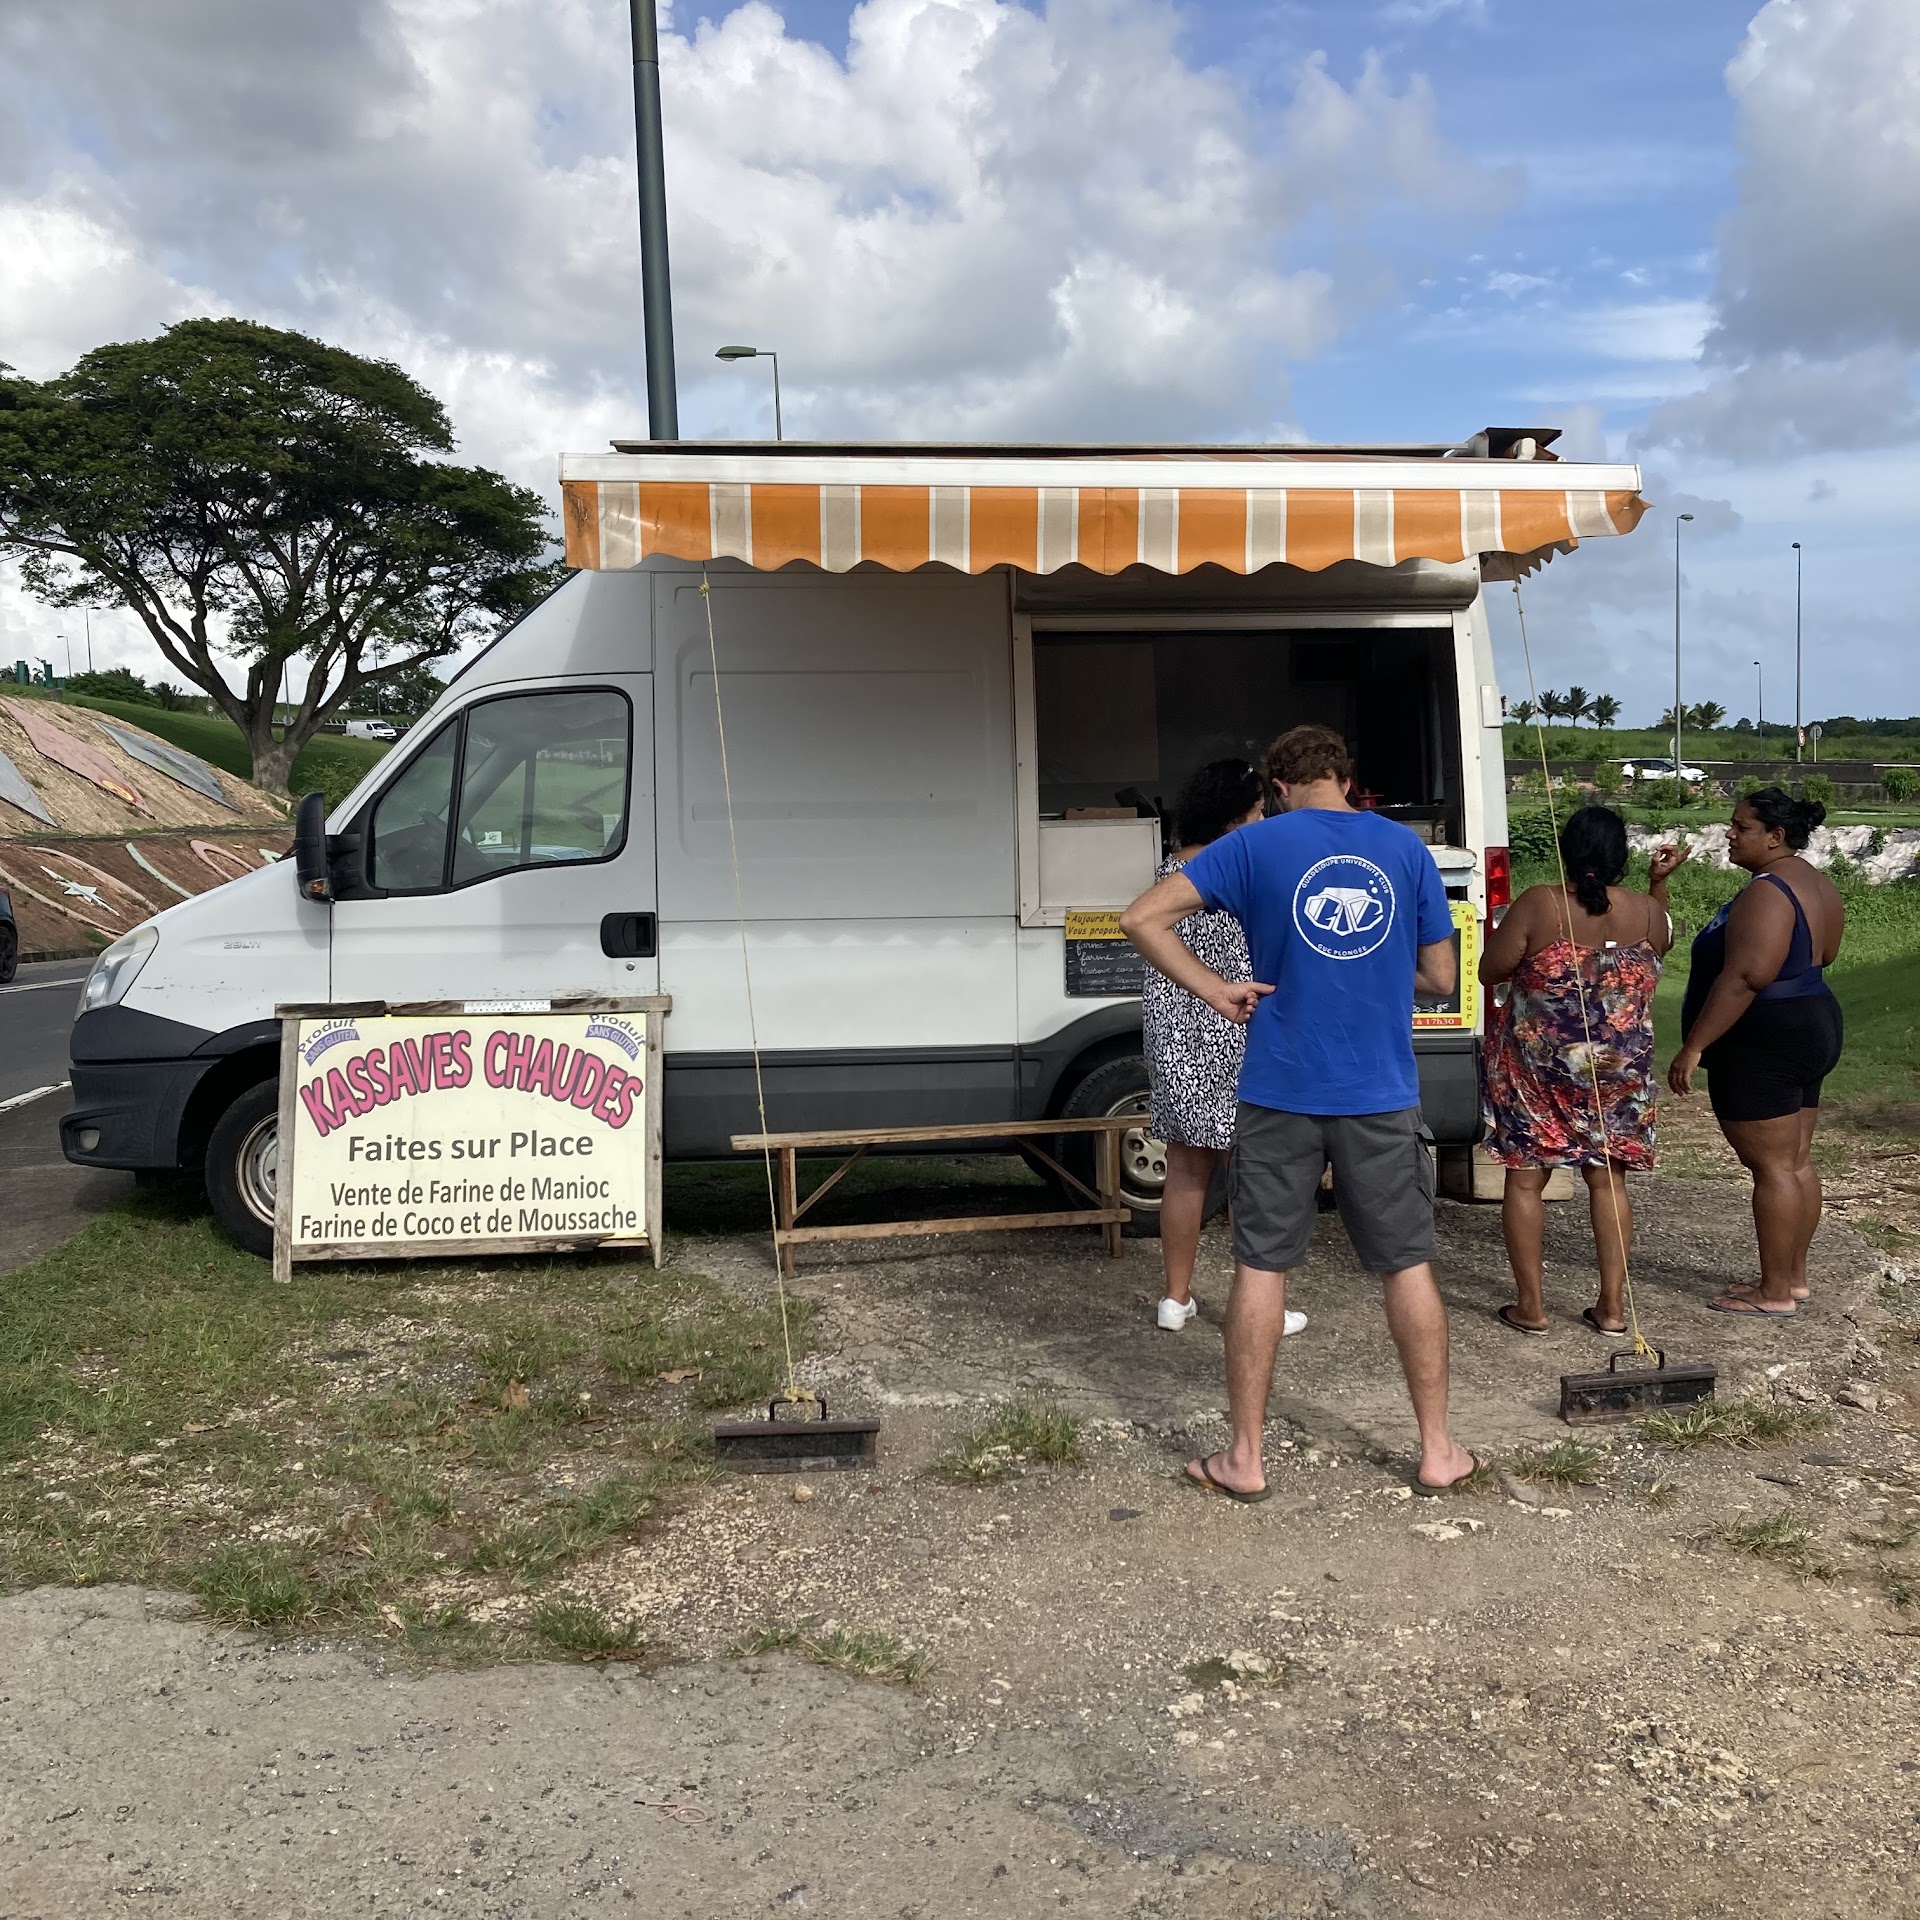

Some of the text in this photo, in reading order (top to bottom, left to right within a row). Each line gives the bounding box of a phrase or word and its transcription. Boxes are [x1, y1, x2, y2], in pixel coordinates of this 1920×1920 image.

[1301, 859, 1339, 889] GUADELOUPE
[1378, 876, 1390, 894] CLUB
[1068, 926, 1088, 935] Vous
[1117, 952, 1141, 960] coco
[1317, 943, 1332, 955] GUC
[1465, 914, 1474, 1020] Menu du Jour
[297, 1018, 357, 1053] Produit
[589, 1014, 647, 1046] Produit
[1425, 1017, 1455, 1025] 17h30
[306, 1030, 357, 1062] SANS GLUTEN
[588, 1026, 639, 1056] SANS GLUTEN
[300, 1029, 645, 1138] KASSAVES CHAUDES
[348, 1130, 594, 1162] Faites sur Place
[330, 1175, 610, 1207] Vente de Farine de Manioc
[300, 1205, 637, 1239] Farine de Coco et de Moussache
